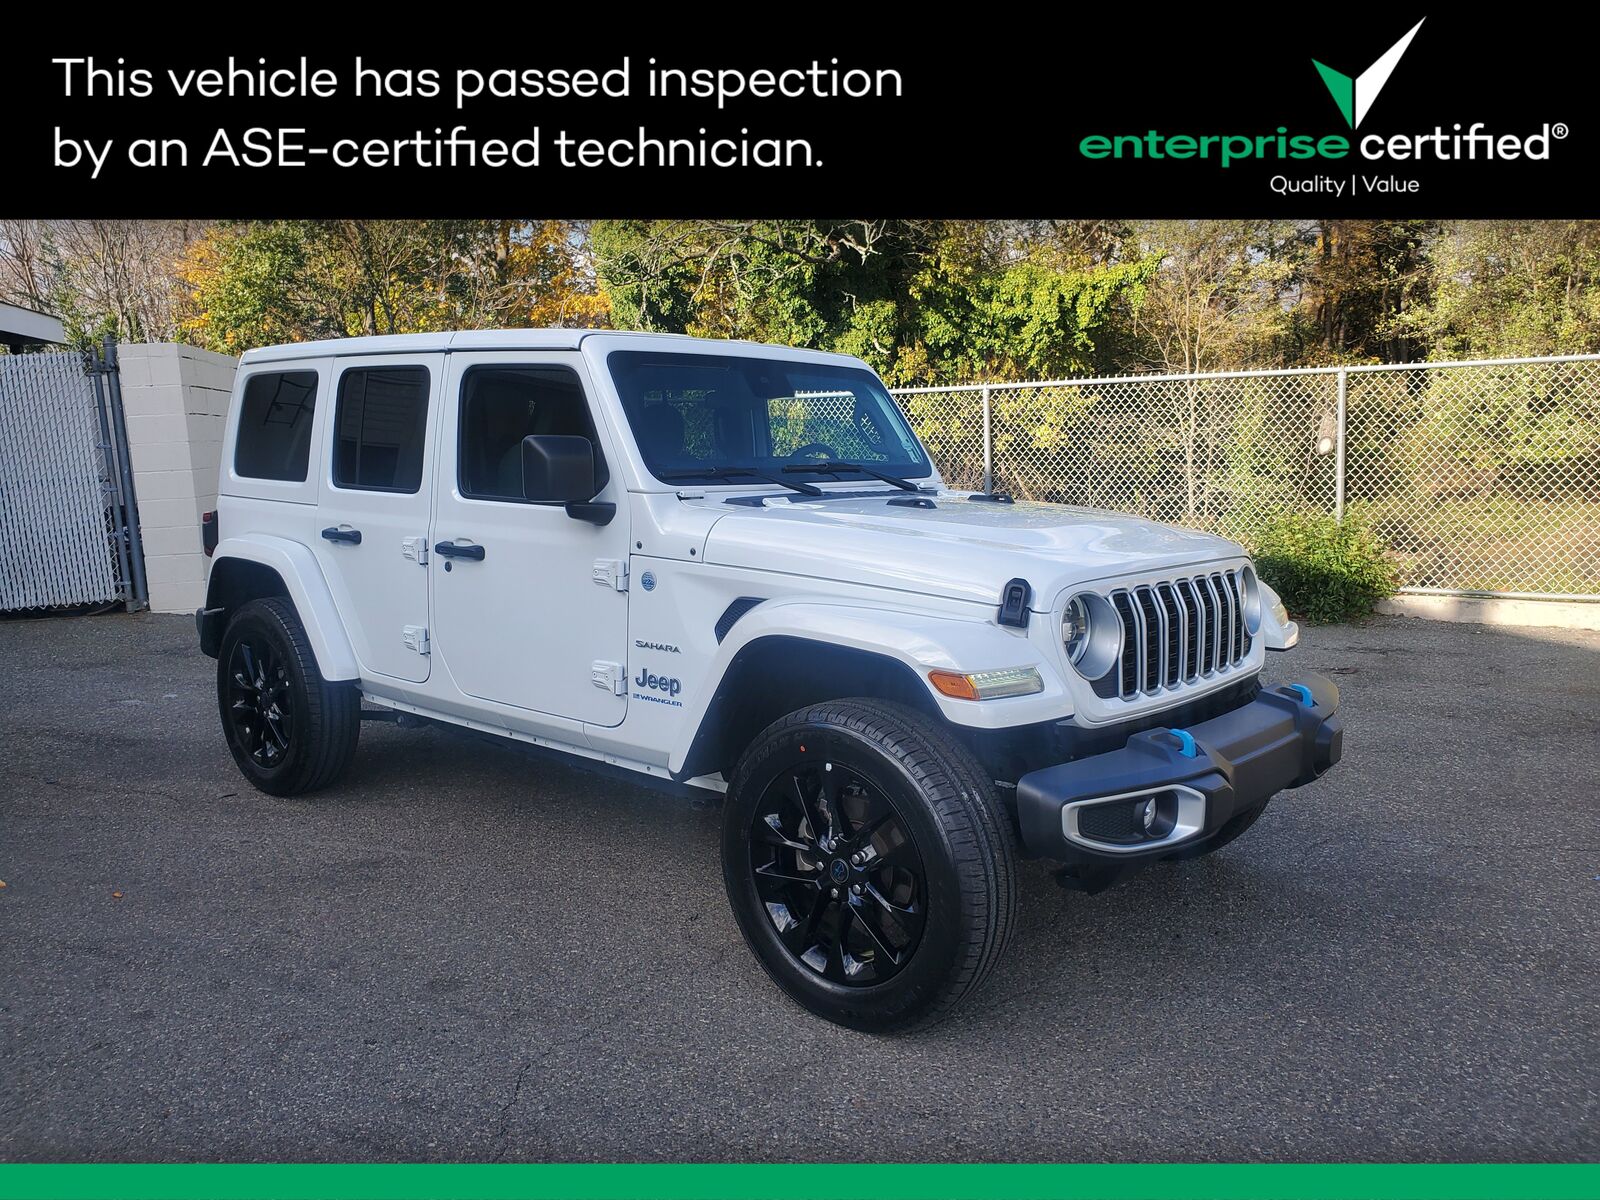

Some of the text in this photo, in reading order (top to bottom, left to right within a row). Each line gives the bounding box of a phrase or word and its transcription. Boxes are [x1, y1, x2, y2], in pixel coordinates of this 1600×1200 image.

[635, 639, 682, 654] SAHARA
[635, 668, 681, 697] Jeep
[640, 694, 683, 707] WRANGLER
